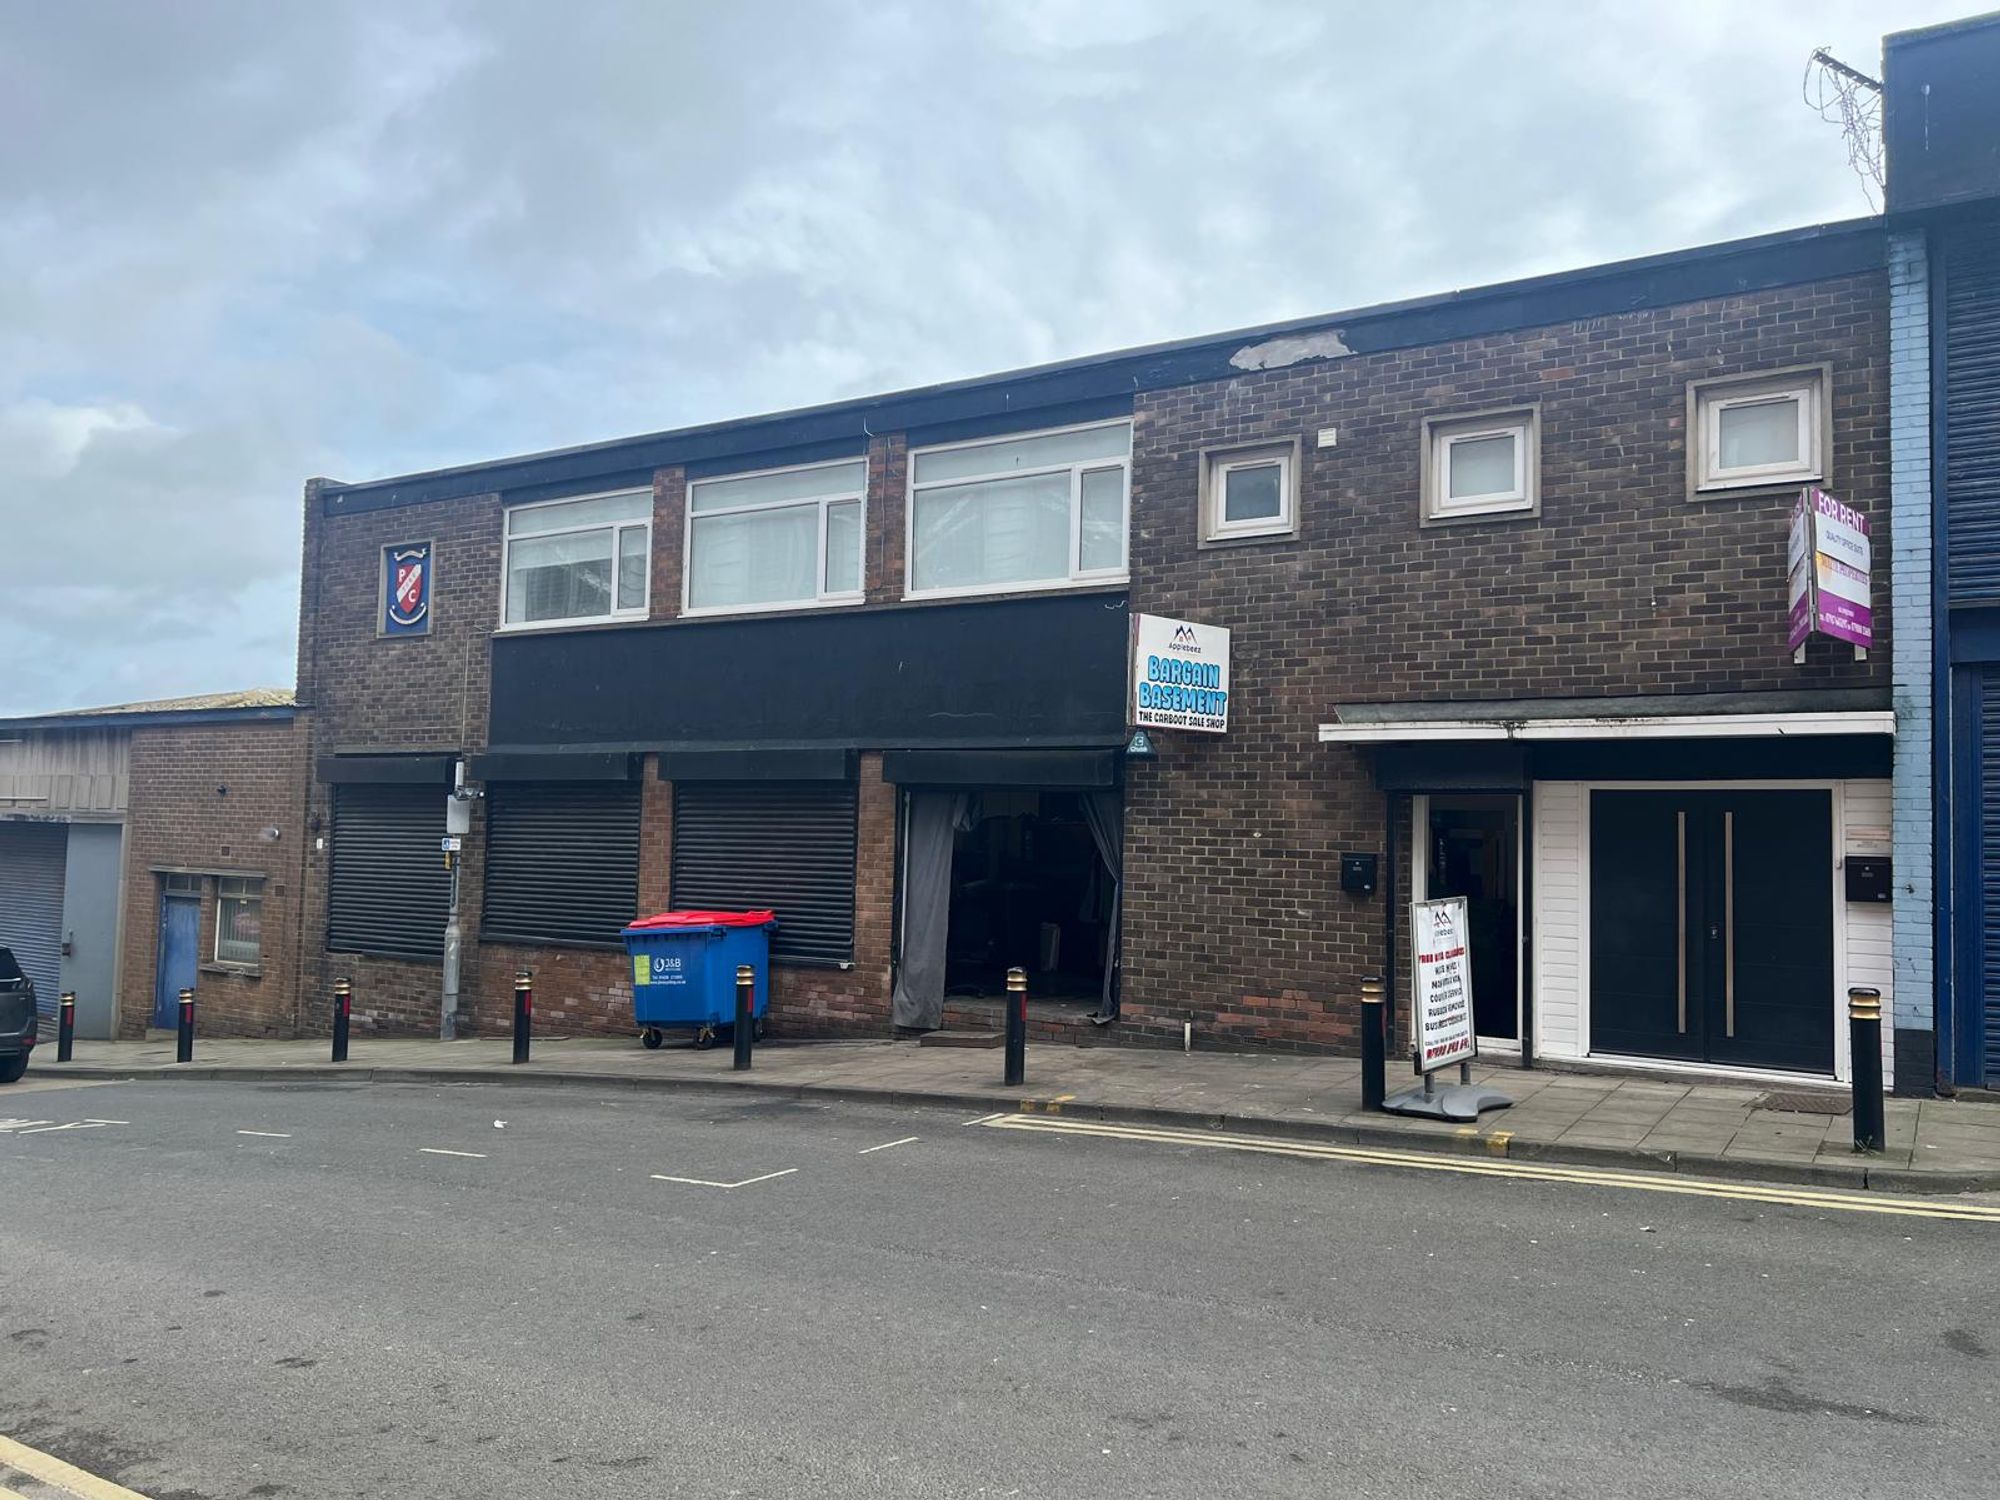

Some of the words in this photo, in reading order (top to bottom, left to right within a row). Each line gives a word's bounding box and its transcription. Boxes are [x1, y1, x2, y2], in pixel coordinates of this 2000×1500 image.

[1818, 491, 1839, 520] FOR
[1840, 503, 1865, 534] RENT
[1147, 655, 1220, 689] BARGAIN
[1138, 682, 1228, 717] BASEMENT
[1139, 711, 1153, 722] THE
[1154, 712, 1188, 726] CARBOOT
[1188, 716, 1205, 728] SALE
[1206, 718, 1225, 729] SHOP
